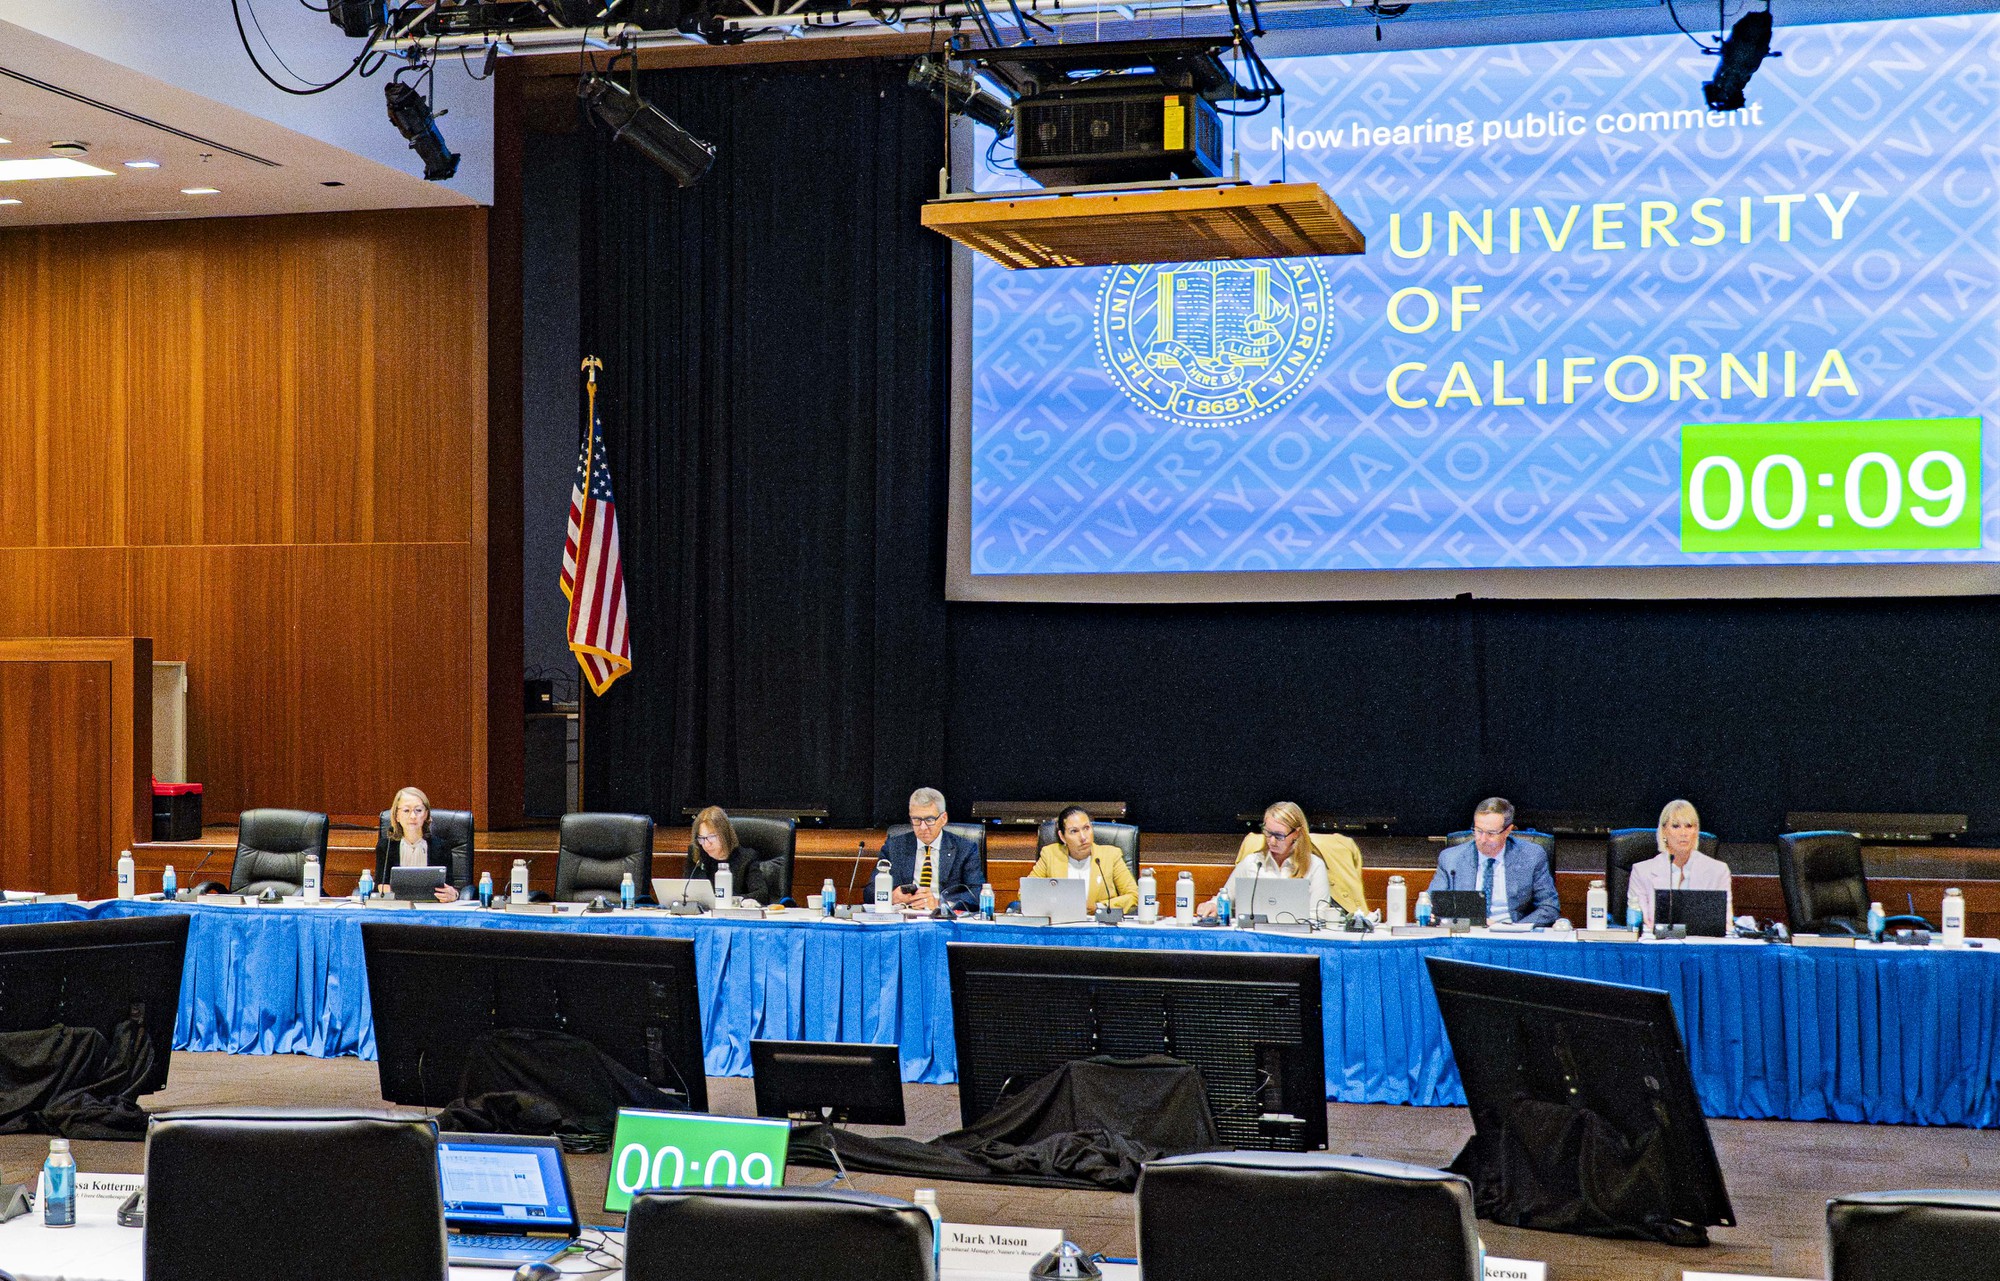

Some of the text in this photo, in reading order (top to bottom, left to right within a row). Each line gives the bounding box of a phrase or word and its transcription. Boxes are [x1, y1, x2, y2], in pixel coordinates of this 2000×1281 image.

[1271, 101, 1763, 151] Now hearing public comment
[1388, 191, 1860, 259] UNIVERSITY
[1386, 284, 1483, 334] OF
[1118, 347, 1153, 392] THE
[1164, 343, 1269, 386] LET THERE BE LIGHT
[1385, 348, 1860, 409] CALIFORNIA
[1186, 398, 1240, 415] 1868
[1689, 450, 1967, 531] 00:09
[952, 1232, 1028, 1247] Mark Mason
[1484, 1266, 1528, 1280] kerson
